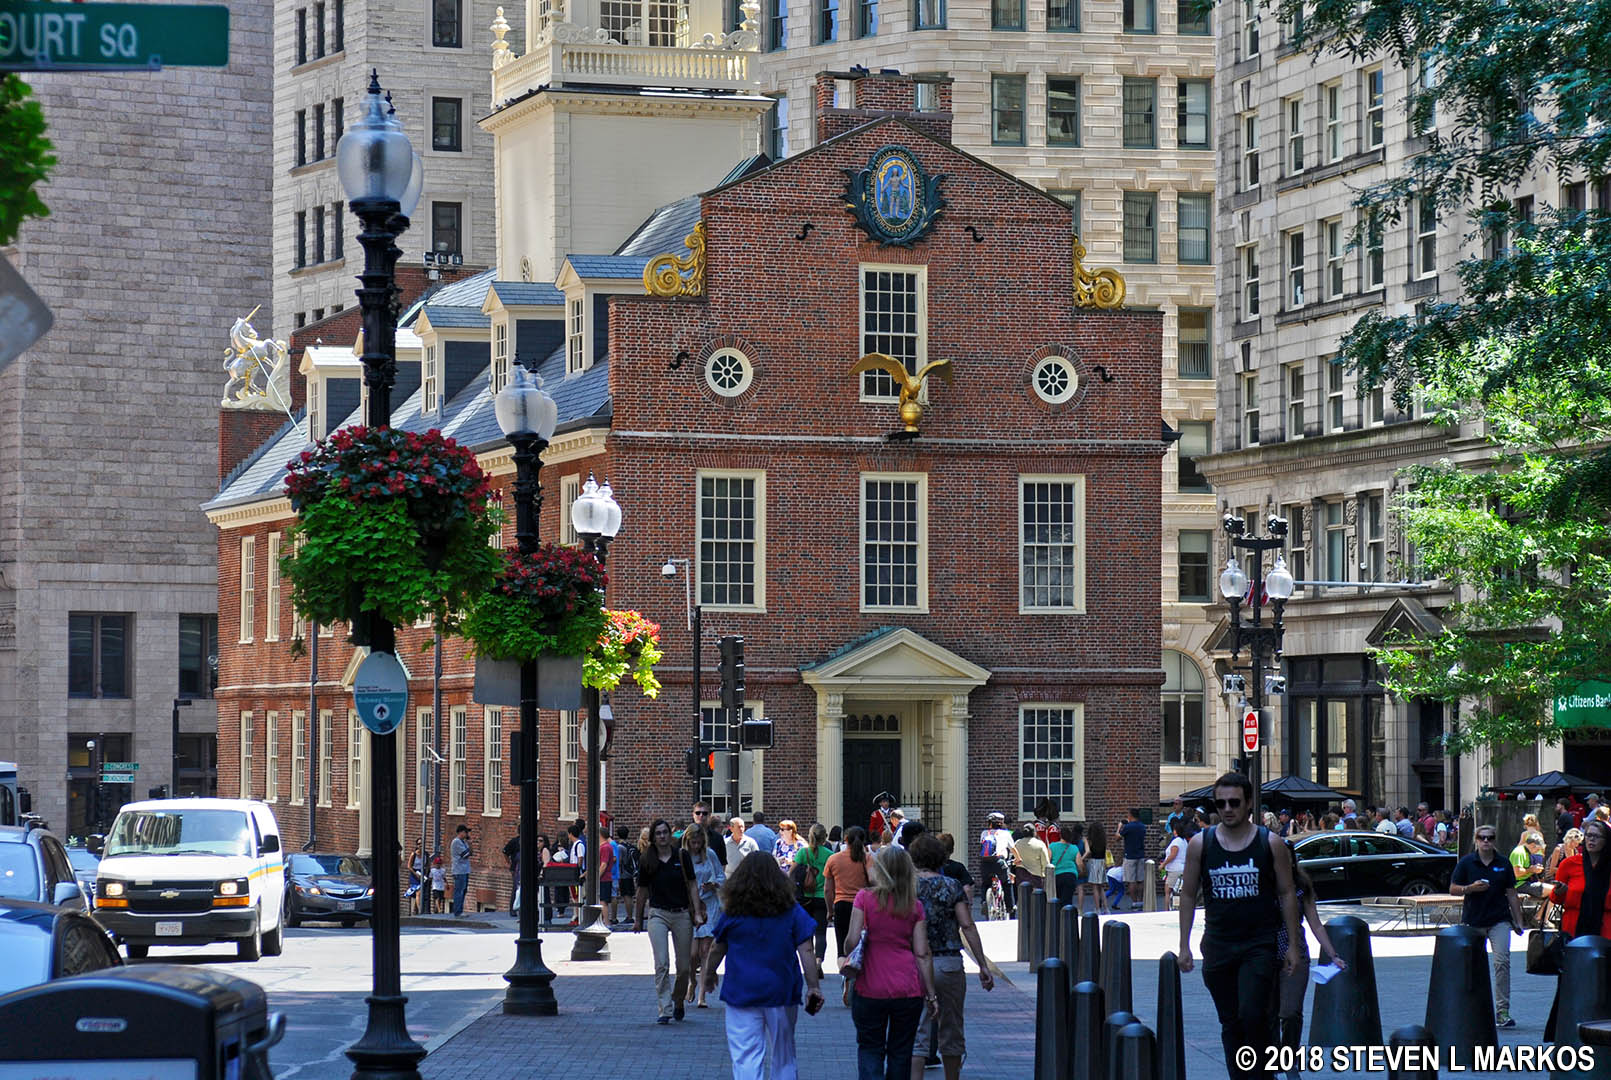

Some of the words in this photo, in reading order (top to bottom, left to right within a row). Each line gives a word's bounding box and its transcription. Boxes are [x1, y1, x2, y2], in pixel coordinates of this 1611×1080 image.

[100, 24, 137, 57] SQ
[1569, 694, 1594, 708] Citizens
[1595, 693, 1611, 708] Ban
[1210, 873, 1259, 887] BOSTON
[1211, 884, 1259, 899] STRONG
